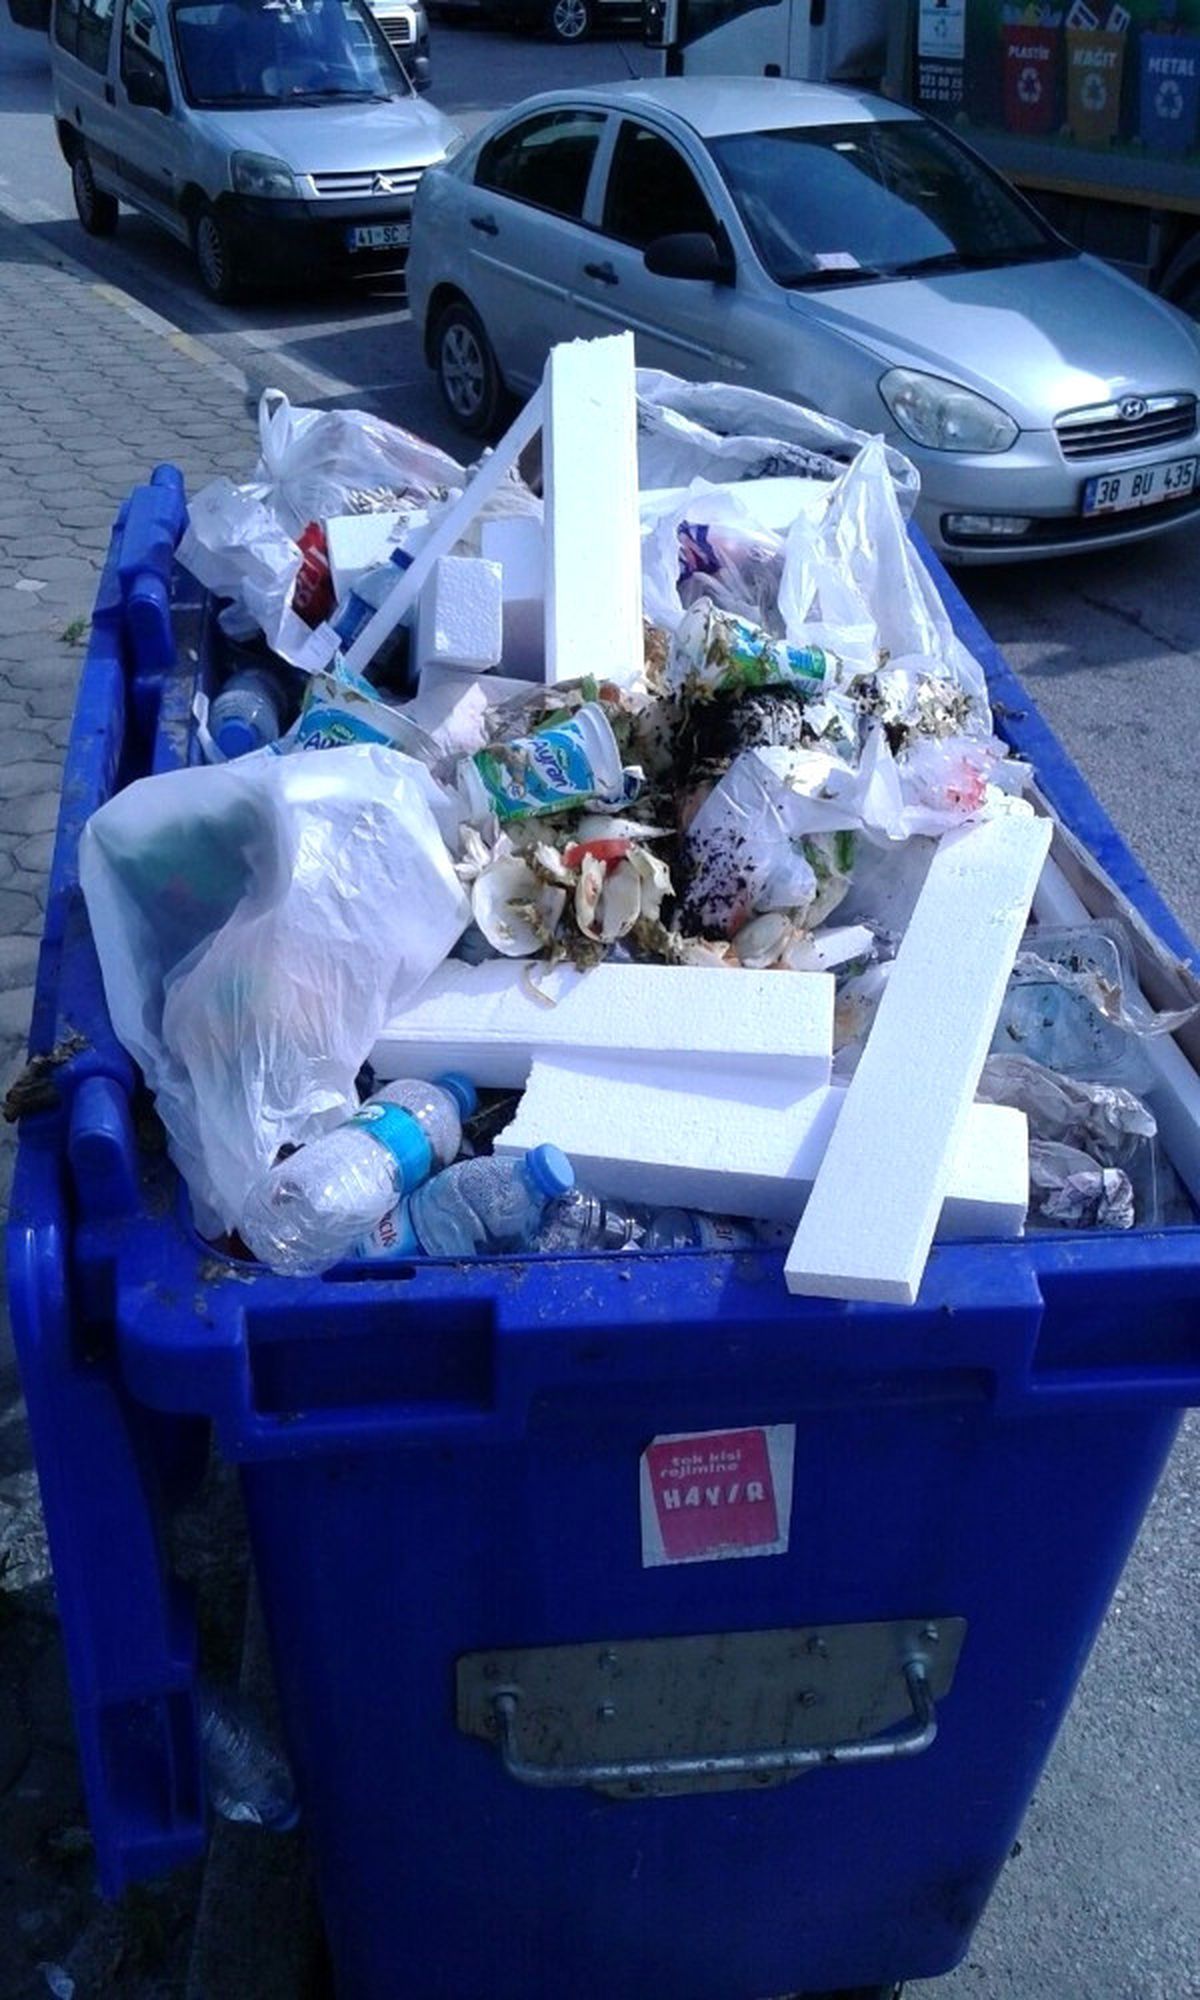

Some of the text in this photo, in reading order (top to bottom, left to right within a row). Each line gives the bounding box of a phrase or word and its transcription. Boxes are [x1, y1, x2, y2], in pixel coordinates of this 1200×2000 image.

[1149, 57, 1197, 77] METAL
[383, 226, 400, 243] SC
[1097, 461, 1194, 504] 38 BU 435
